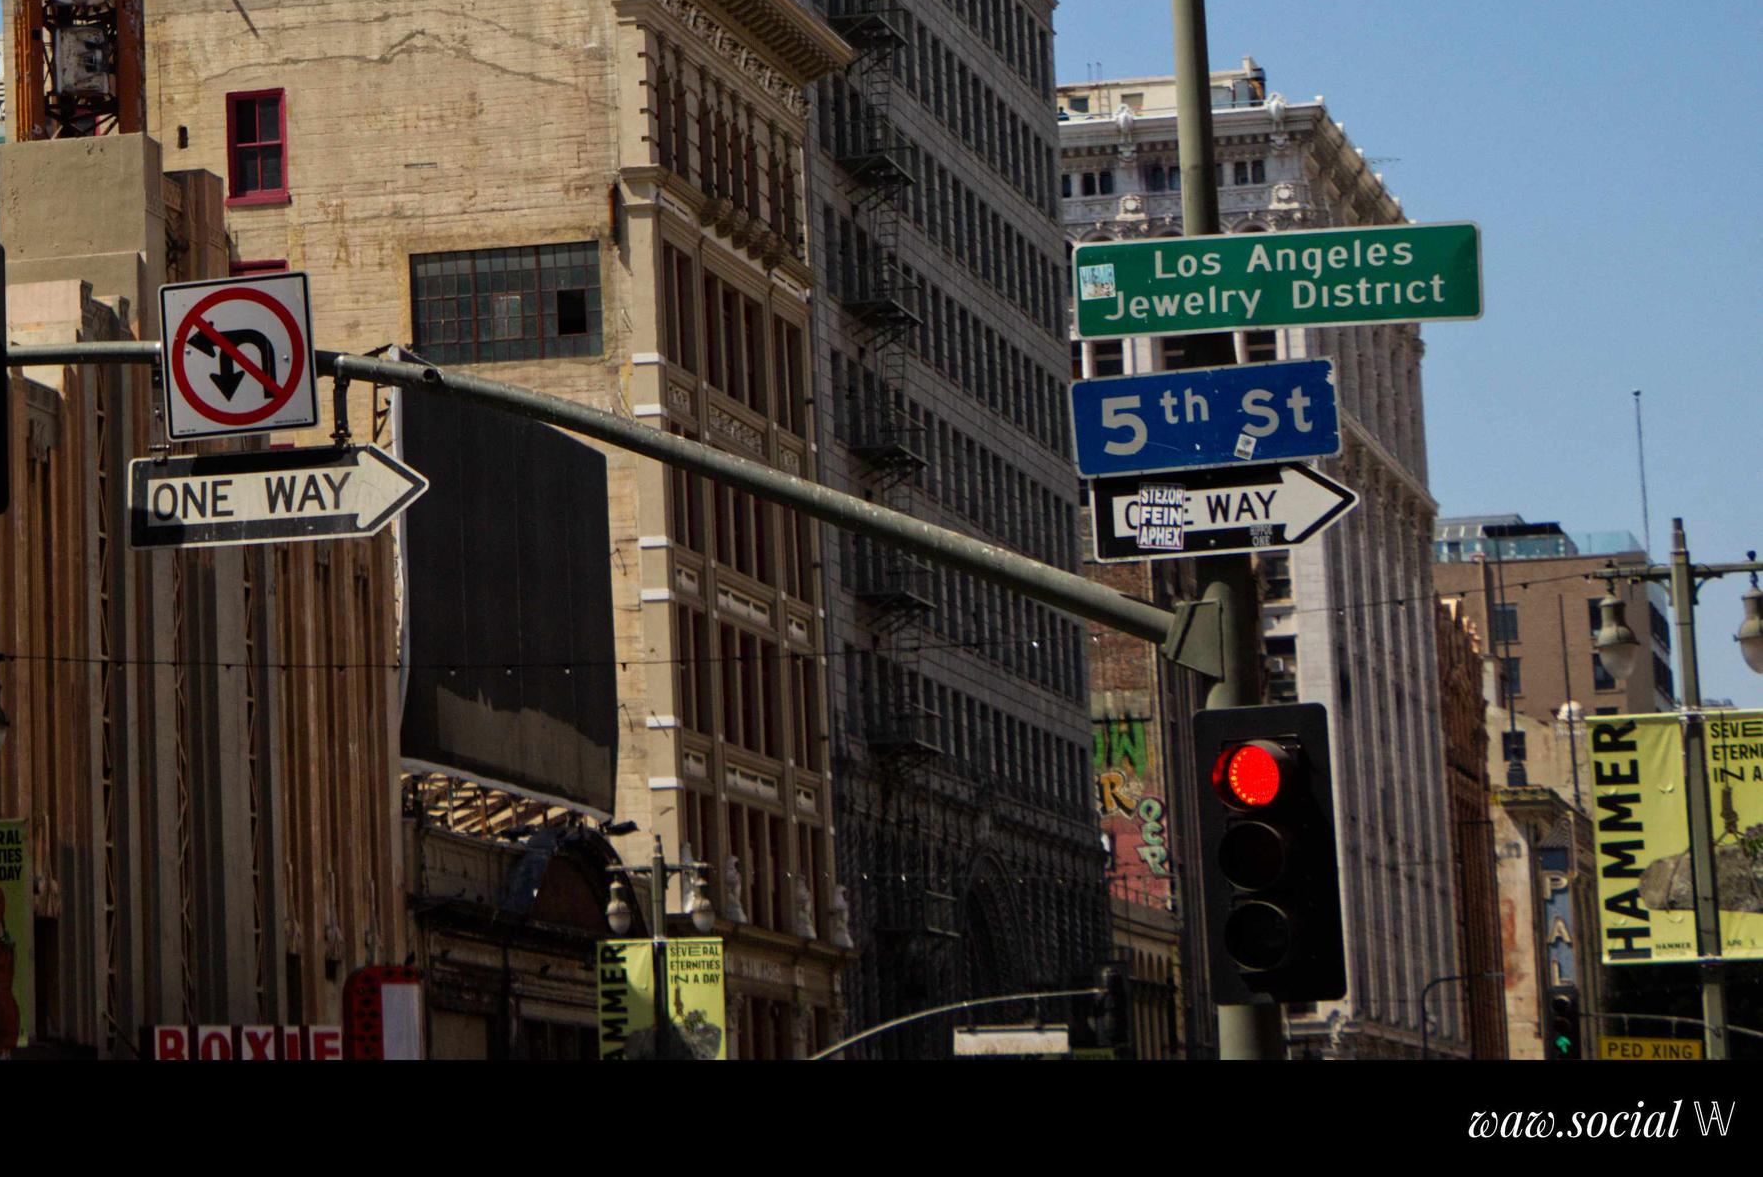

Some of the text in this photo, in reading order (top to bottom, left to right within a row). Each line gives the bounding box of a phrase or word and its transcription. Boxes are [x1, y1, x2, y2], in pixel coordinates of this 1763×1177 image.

[1153, 239, 1414, 279] Los Angeles
[1104, 273, 1445, 320] Jewelry District
[1101, 385, 1313, 456] 5th St
[152, 471, 353, 523] ONE WAY
[1140, 488, 1183, 505] STEZOR
[1206, 489, 1277, 523] WAY
[1141, 505, 1182, 525] FEIN
[1140, 526, 1181, 546] APHEX
[1714, 765, 1745, 784] IN
[1593, 719, 1653, 960] HAMMER
[670, 945, 720, 957] SEVERAL
[670, 959, 721, 971] ETERNITIES
[670, 972, 721, 984] IN A DAY
[1608, 1042, 1693, 1060] PED XING
